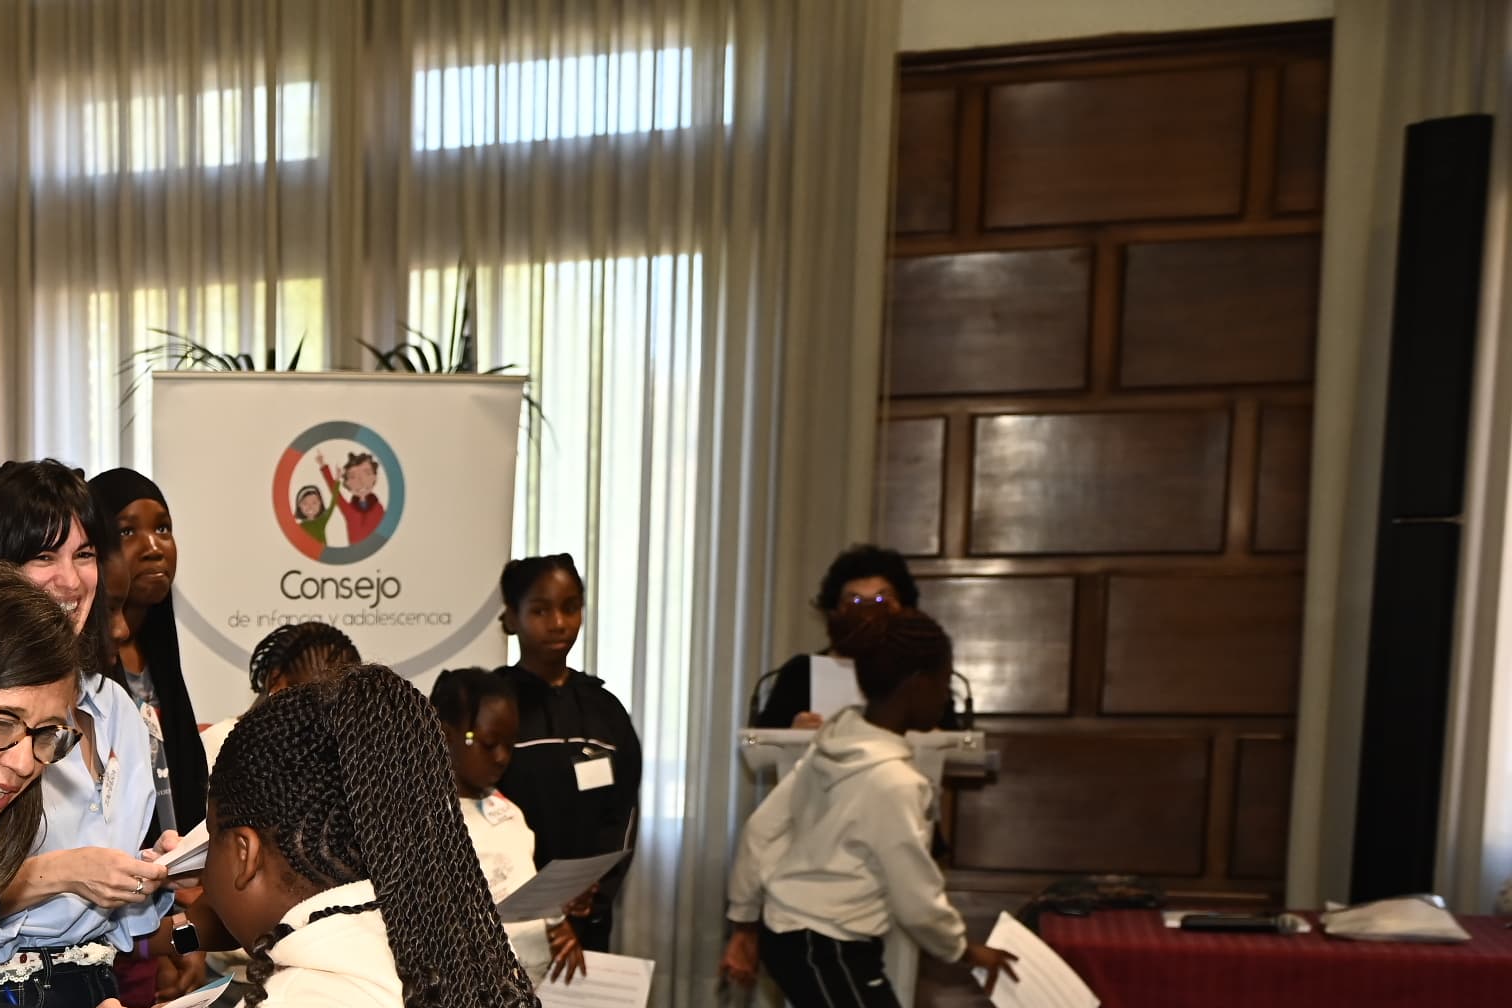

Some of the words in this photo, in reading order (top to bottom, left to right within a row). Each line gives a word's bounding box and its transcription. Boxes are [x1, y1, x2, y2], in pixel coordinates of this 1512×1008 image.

[280, 568, 402, 609] Consejo
[227, 611, 250, 628] de
[329, 613, 337, 627] y
[342, 607, 452, 626] adolescencia
